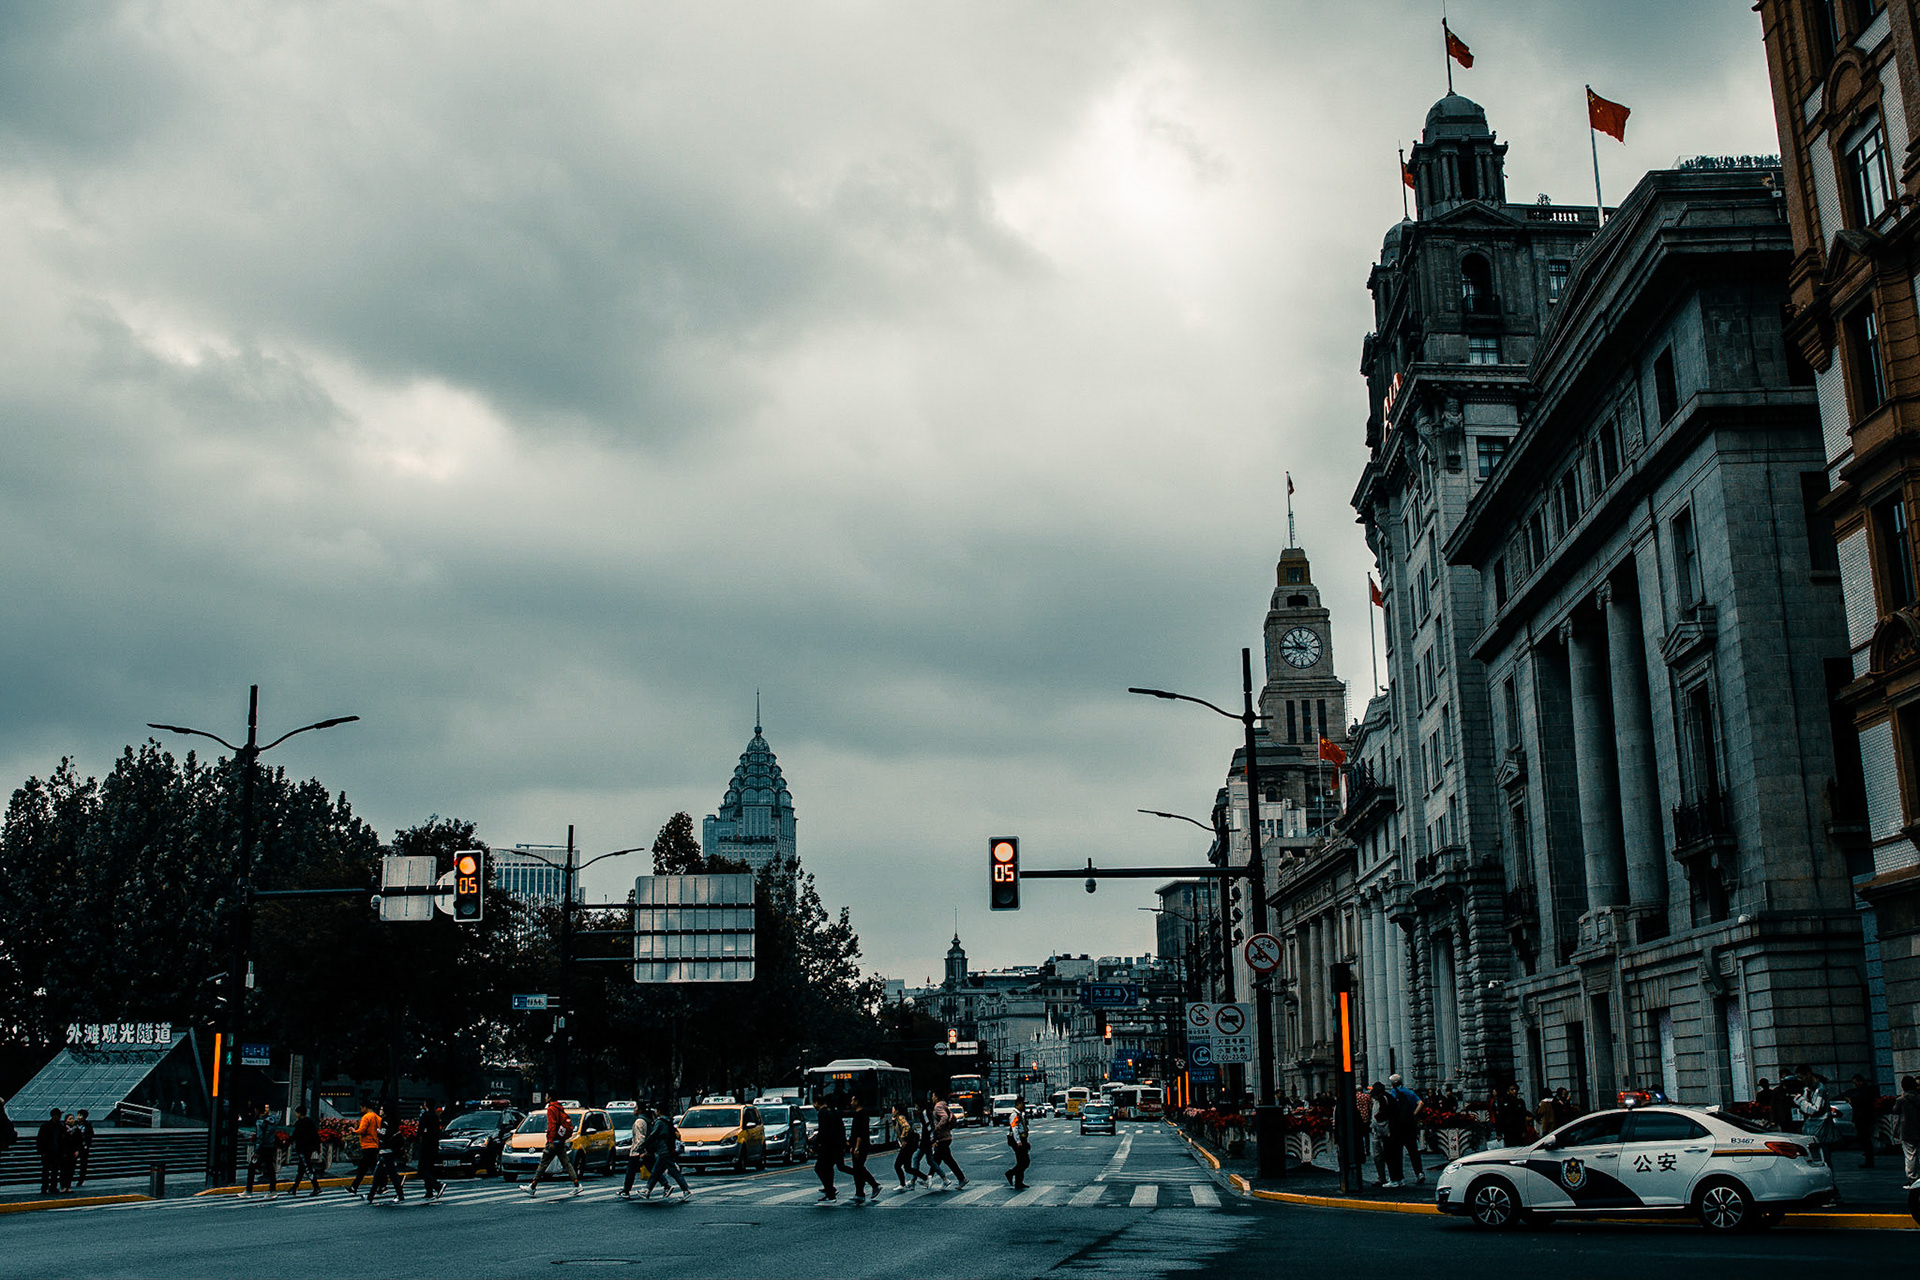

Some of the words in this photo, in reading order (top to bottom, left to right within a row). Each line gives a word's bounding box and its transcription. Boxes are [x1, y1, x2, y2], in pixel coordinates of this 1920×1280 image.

[994, 864, 1015, 882] 05
[458, 877, 477, 894] 05
[66, 1022, 173, 1045] 外滩观光隧道
[1632, 1152, 1677, 1174] 公安
